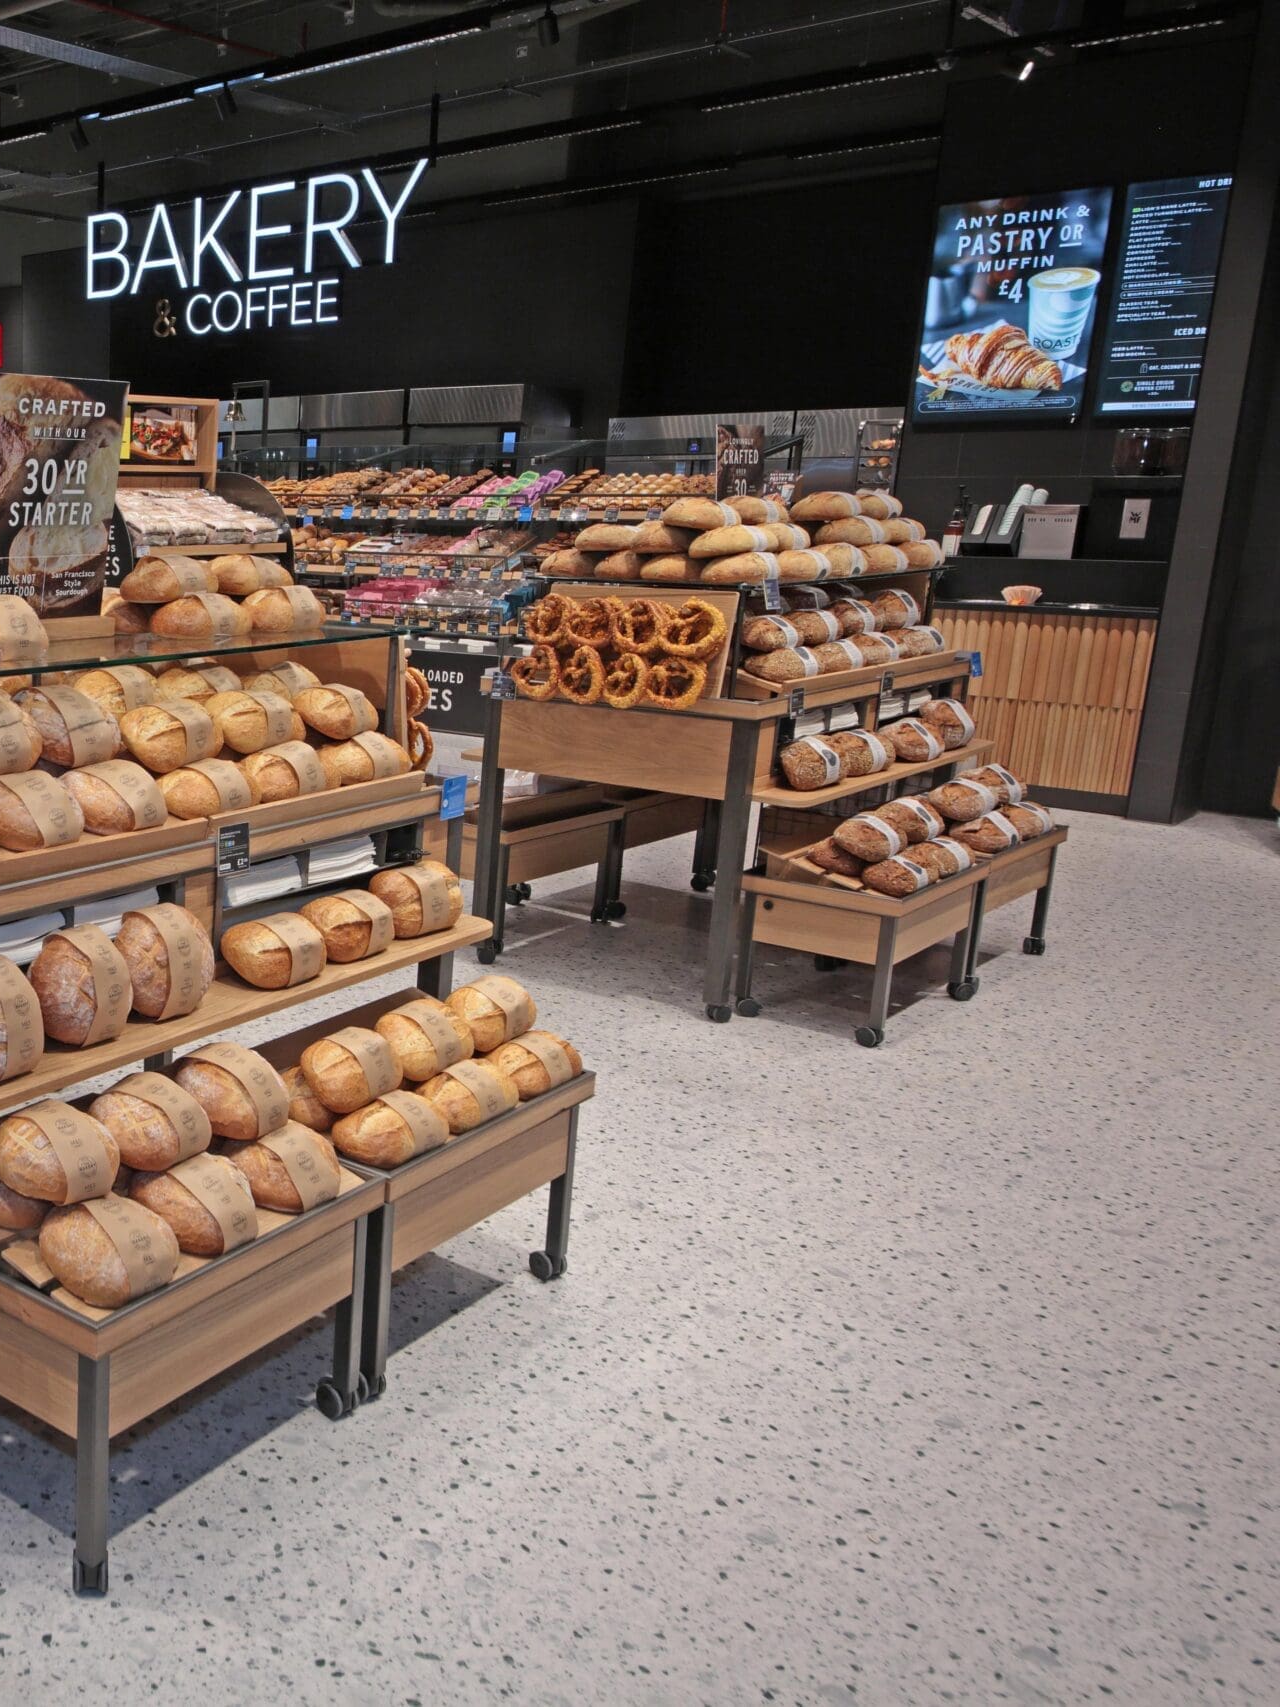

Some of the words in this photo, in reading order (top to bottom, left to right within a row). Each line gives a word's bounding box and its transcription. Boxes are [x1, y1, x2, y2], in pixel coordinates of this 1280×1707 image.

[1199, 180, 1216, 188] HOT
[955, 214, 998, 231] ANY
[1003, 207, 1070, 226] DRINK
[1077, 205, 1090, 218] &
[86, 158, 429, 300] BAKERY
[957, 226, 1053, 257] PASTRY
[1060, 224, 1083, 242] OR
[977, 255, 1054, 273] MUFFIN
[999, 279, 1023, 303] £4
[153, 299, 177, 337] &
[186, 279, 339, 335] COFFEE
[1174, 328, 1194, 336] ICED
[1033, 333, 1080, 350] ROAST
[19, 398, 106, 418] CRAFTED
[34, 426, 61, 438] WITH
[66, 428, 87, 439] OUR
[723, 449, 759, 465] CRAFTED
[23, 459, 57, 495] 30
[63, 460, 88, 484] YR
[734, 479, 747, 496] 30
[8, 502, 93, 527] STARTER
[12, 575, 20, 585] IS
[21, 574, 36, 585] NOT
[64, 580, 81, 588] Style
[14, 586, 35, 596] FOOD
[55, 588, 88, 597] Sourdough
